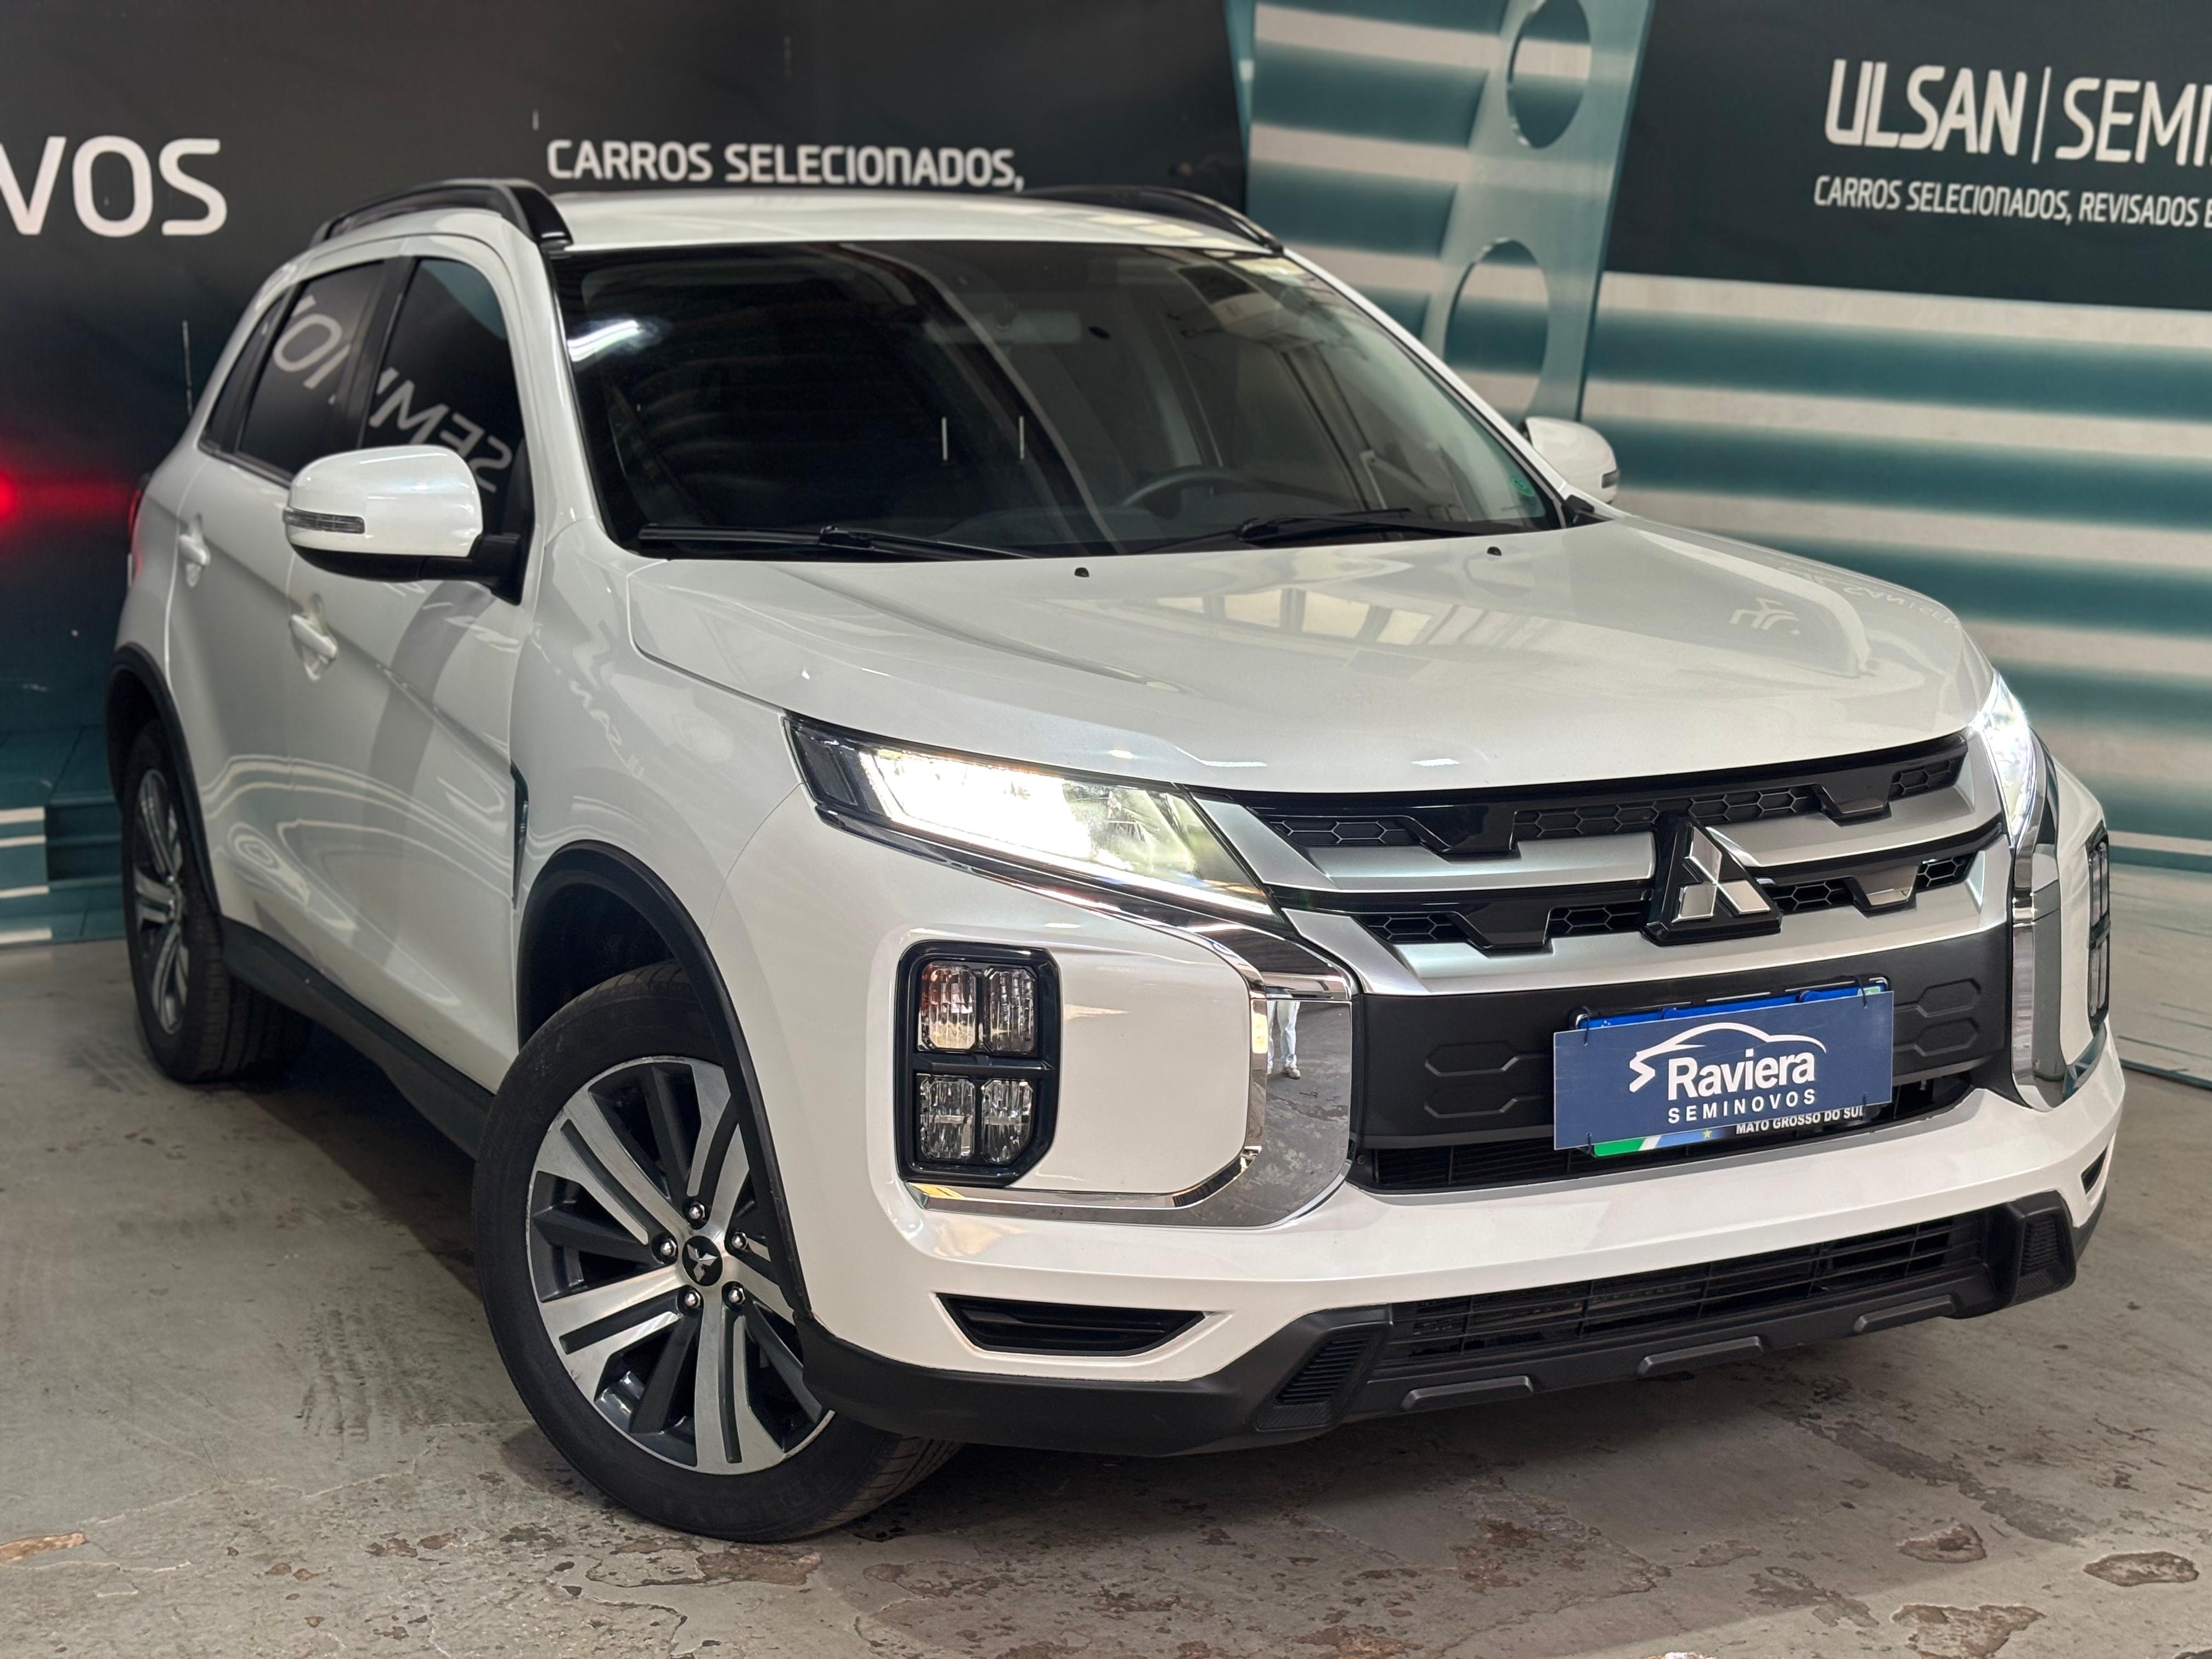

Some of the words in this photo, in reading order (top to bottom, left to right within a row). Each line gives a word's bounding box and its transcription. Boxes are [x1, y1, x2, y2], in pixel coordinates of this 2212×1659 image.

[1825, 59, 2028, 156] ULSAN
[2055, 77, 2212, 167] SEMI
[0, 136, 227, 237] VOS
[548, 140, 713, 181] CARROS
[725, 144, 1024, 192] SELECIONADOS,
[1814, 176, 1903, 210] CARROS
[1906, 181, 2072, 225] SELECIONADOS,
[2079, 191, 2200, 227] REVISADOS
[1668, 1048, 1815, 1101] Raviera
[1668, 1088, 1815, 1124] SEMINOVOS
[1736, 1120, 1769, 1135] MATO
[1773, 1111, 1821, 1129] GROSSO
[1824, 1109, 1841, 1122] DO
